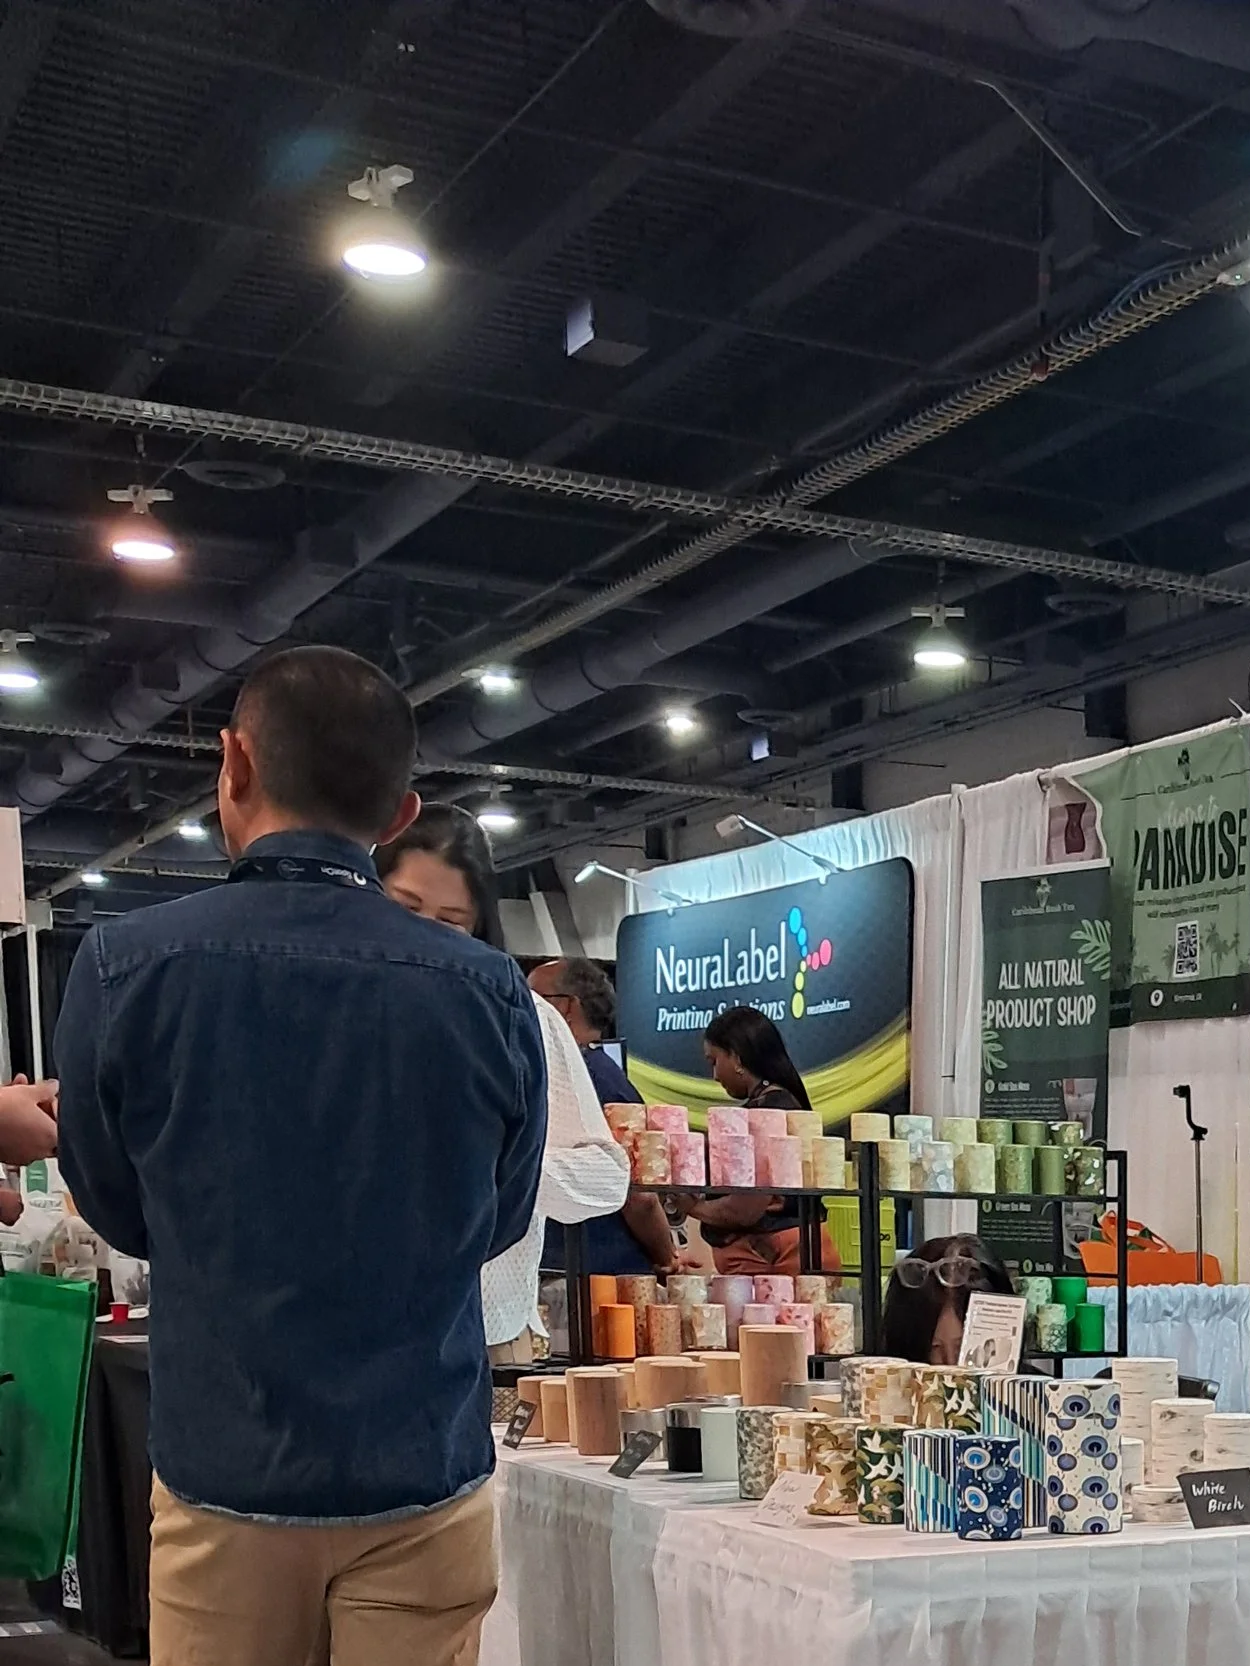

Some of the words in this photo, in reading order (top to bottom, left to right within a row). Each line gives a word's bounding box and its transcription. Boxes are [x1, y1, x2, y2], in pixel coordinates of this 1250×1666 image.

[656, 920, 787, 995] NeuraLabel
[998, 961, 1021, 990] ALL
[1024, 957, 1085, 989] NATURAL
[986, 997, 1053, 1031] PRODUCT
[1057, 994, 1097, 1027] SHOP
[1191, 1480, 1227, 1497] White
[1207, 1494, 1245, 1513] Birch
